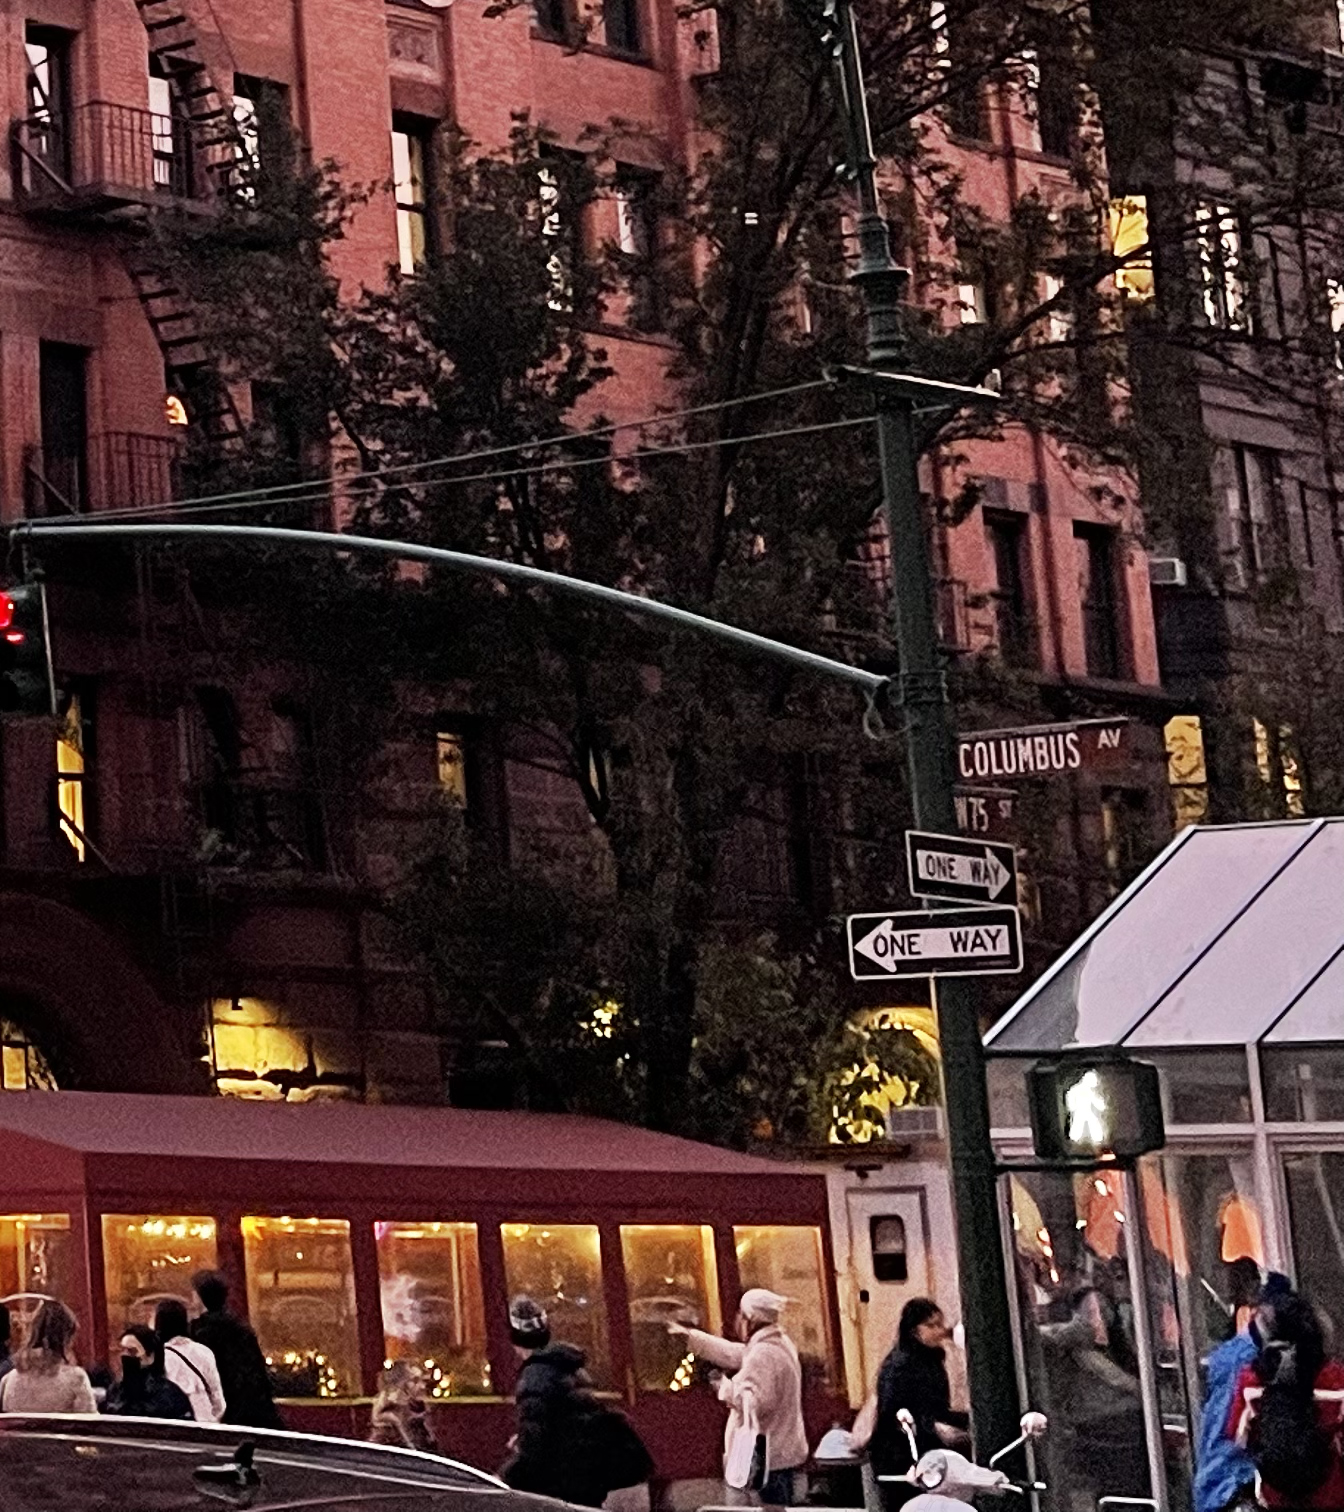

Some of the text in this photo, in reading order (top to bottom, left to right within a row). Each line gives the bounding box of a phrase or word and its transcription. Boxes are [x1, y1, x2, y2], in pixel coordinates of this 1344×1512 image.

[959, 729, 1120, 777] COLUMBUS AV
[925, 854, 1001, 886] ONE WAY
[872, 928, 1002, 958] ONE WAY
